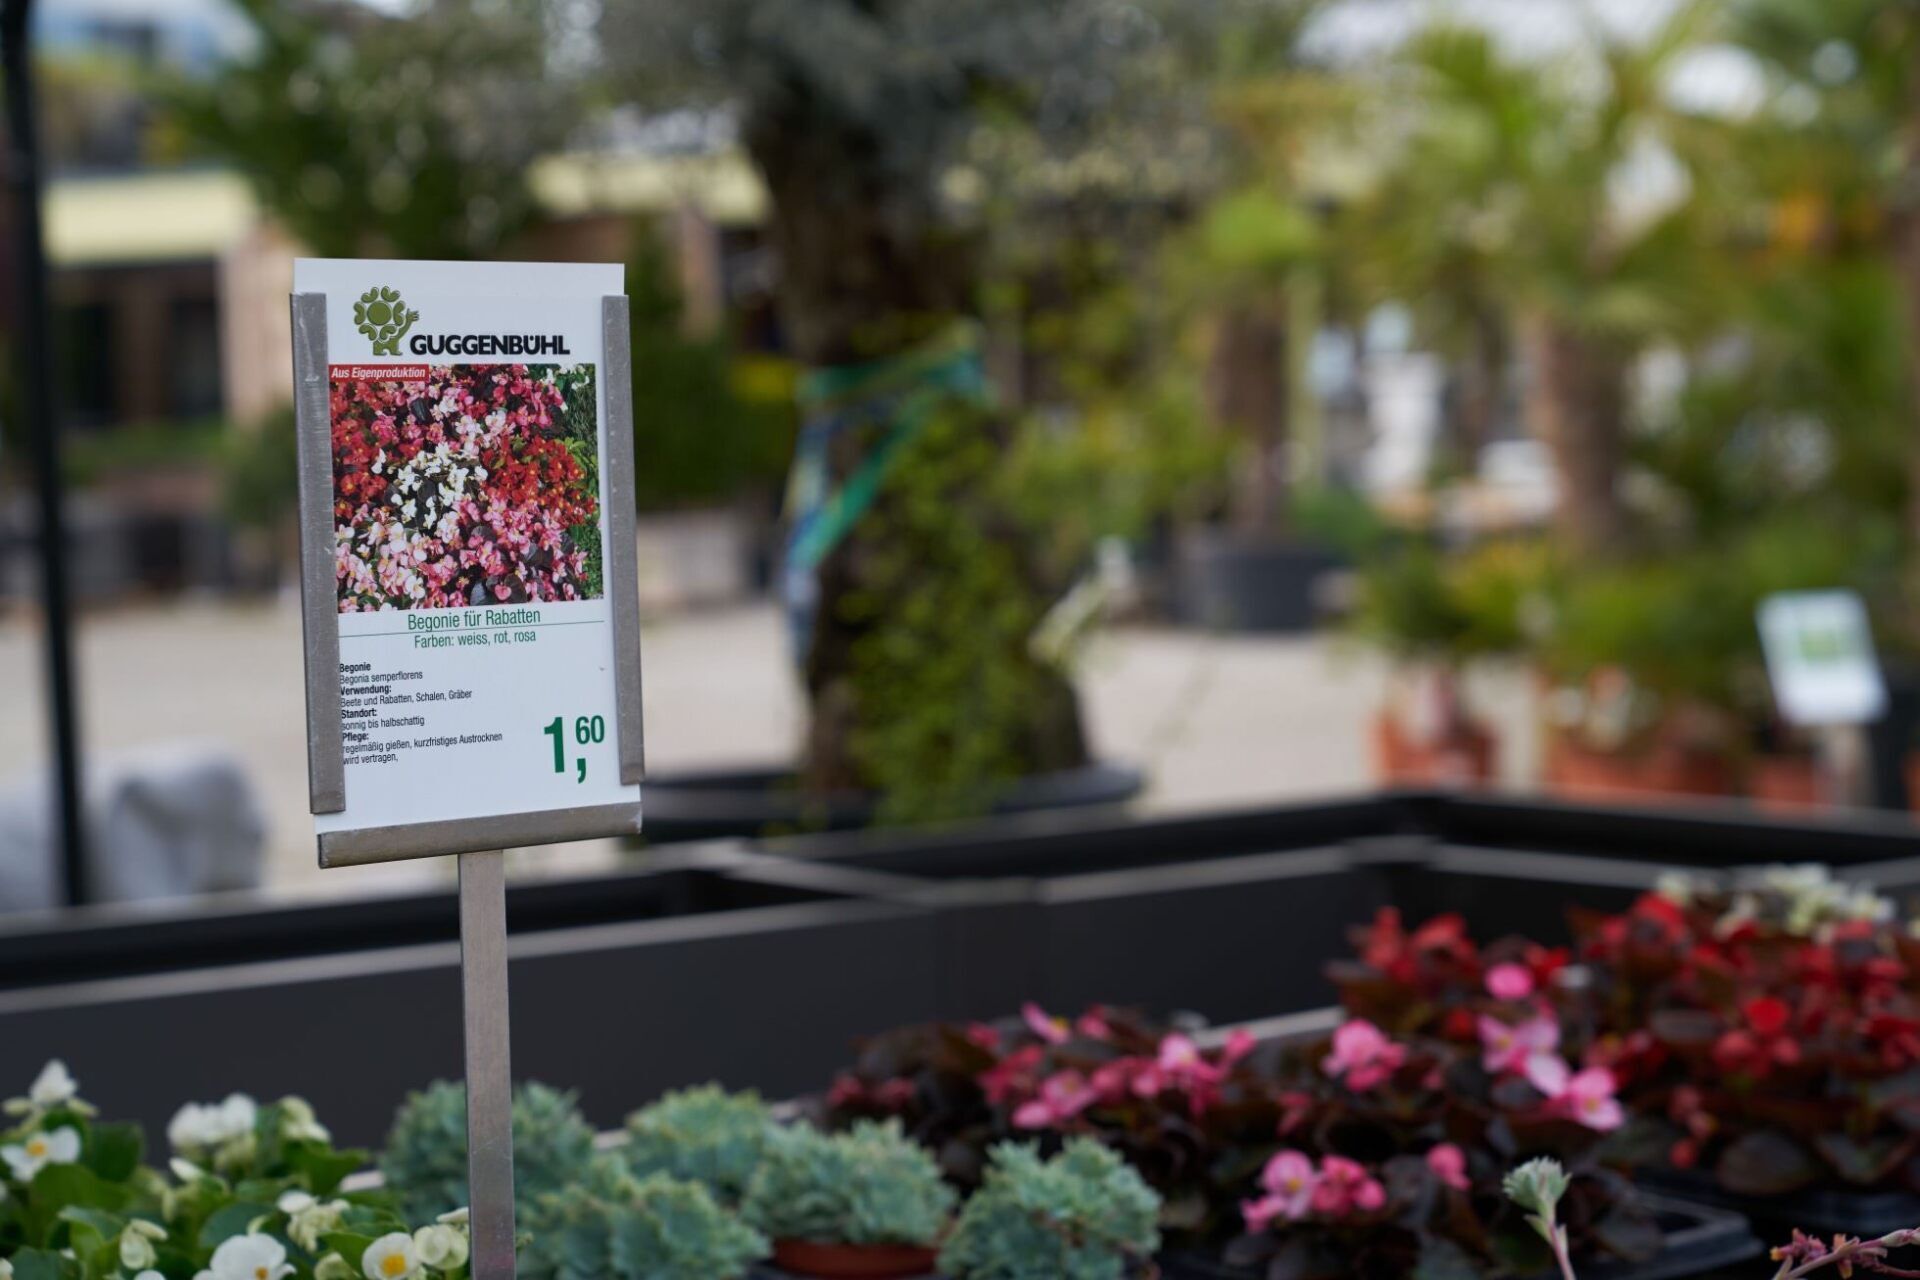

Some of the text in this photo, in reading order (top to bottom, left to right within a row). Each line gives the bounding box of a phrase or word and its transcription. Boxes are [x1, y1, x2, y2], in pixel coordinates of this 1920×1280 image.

[410, 335, 570, 355] GUGGENBÜHL
[331, 367, 426, 379] Aus Eigenproduktion
[408, 608, 541, 632] Begonie für Rabatten
[415, 630, 536, 648] Farben: weiss, rot, rosa
[340, 662, 371, 674] Begonie
[340, 671, 423, 685] Begonia semperflorens
[340, 685, 391, 695] Verwendung:
[341, 690, 472, 707] Beete und Rabatten, Schalen, Gräber
[341, 708, 377, 719] Standort:
[342, 715, 424, 731] sonnig bis halbschattig
[342, 733, 369, 743] Pflege:
[343, 733, 502, 754] regelmäßig gießen, kurzfristiges Austrocknen
[343, 756, 359, 765] wird
